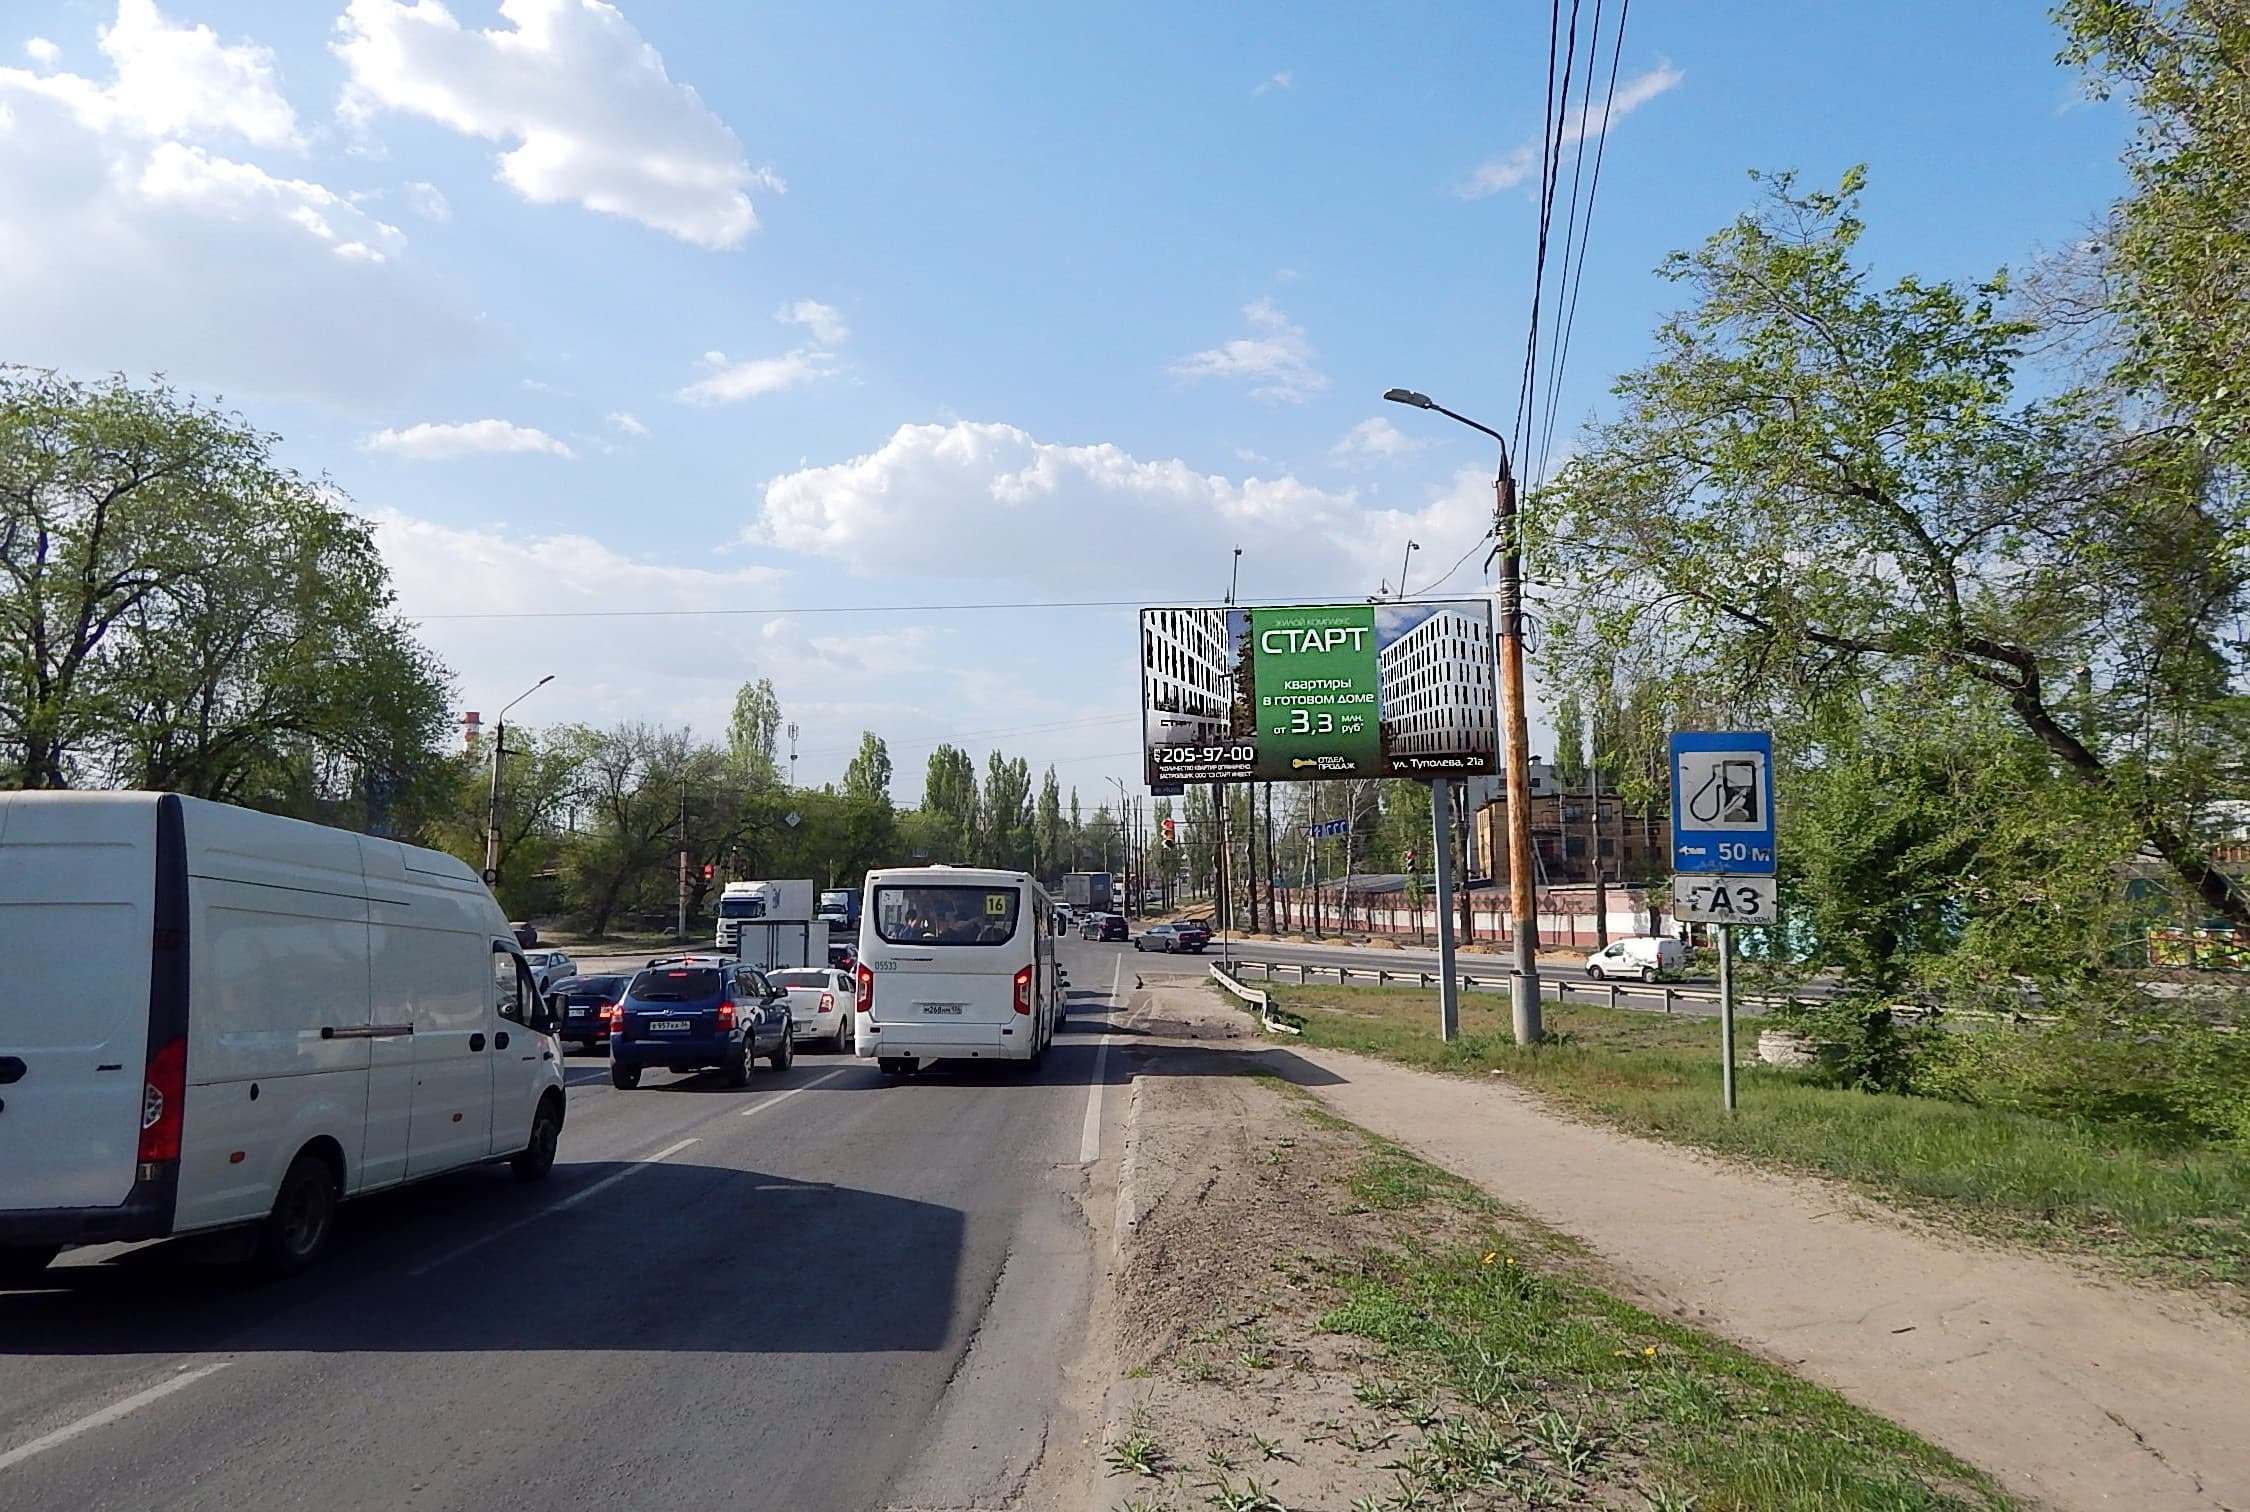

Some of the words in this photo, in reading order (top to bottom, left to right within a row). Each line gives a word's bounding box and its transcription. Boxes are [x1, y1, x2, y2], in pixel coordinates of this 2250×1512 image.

[1261, 627, 1369, 654] СТАРТ
[1284, 678, 1352, 691] квартиры
[1263, 697, 1271, 706] в
[1275, 694, 1335, 705] готовом
[1337, 693, 1375, 704] доме
[1291, 709, 1333, 735] 3,3
[1162, 746, 1254, 763] 205-97-00
[1317, 756, 1344, 764] ОТДЕЛ
[1318, 762, 1355, 770] ПРОДАЖ
[1392, 761, 1408, 770] ул.
[1410, 758, 1464, 769] Туполева,
[1466, 757, 1484, 766] 21а
[1718, 843, 1747, 861] 50
[988, 898, 1004, 912] 16
[874, 961, 897, 971] 05533
